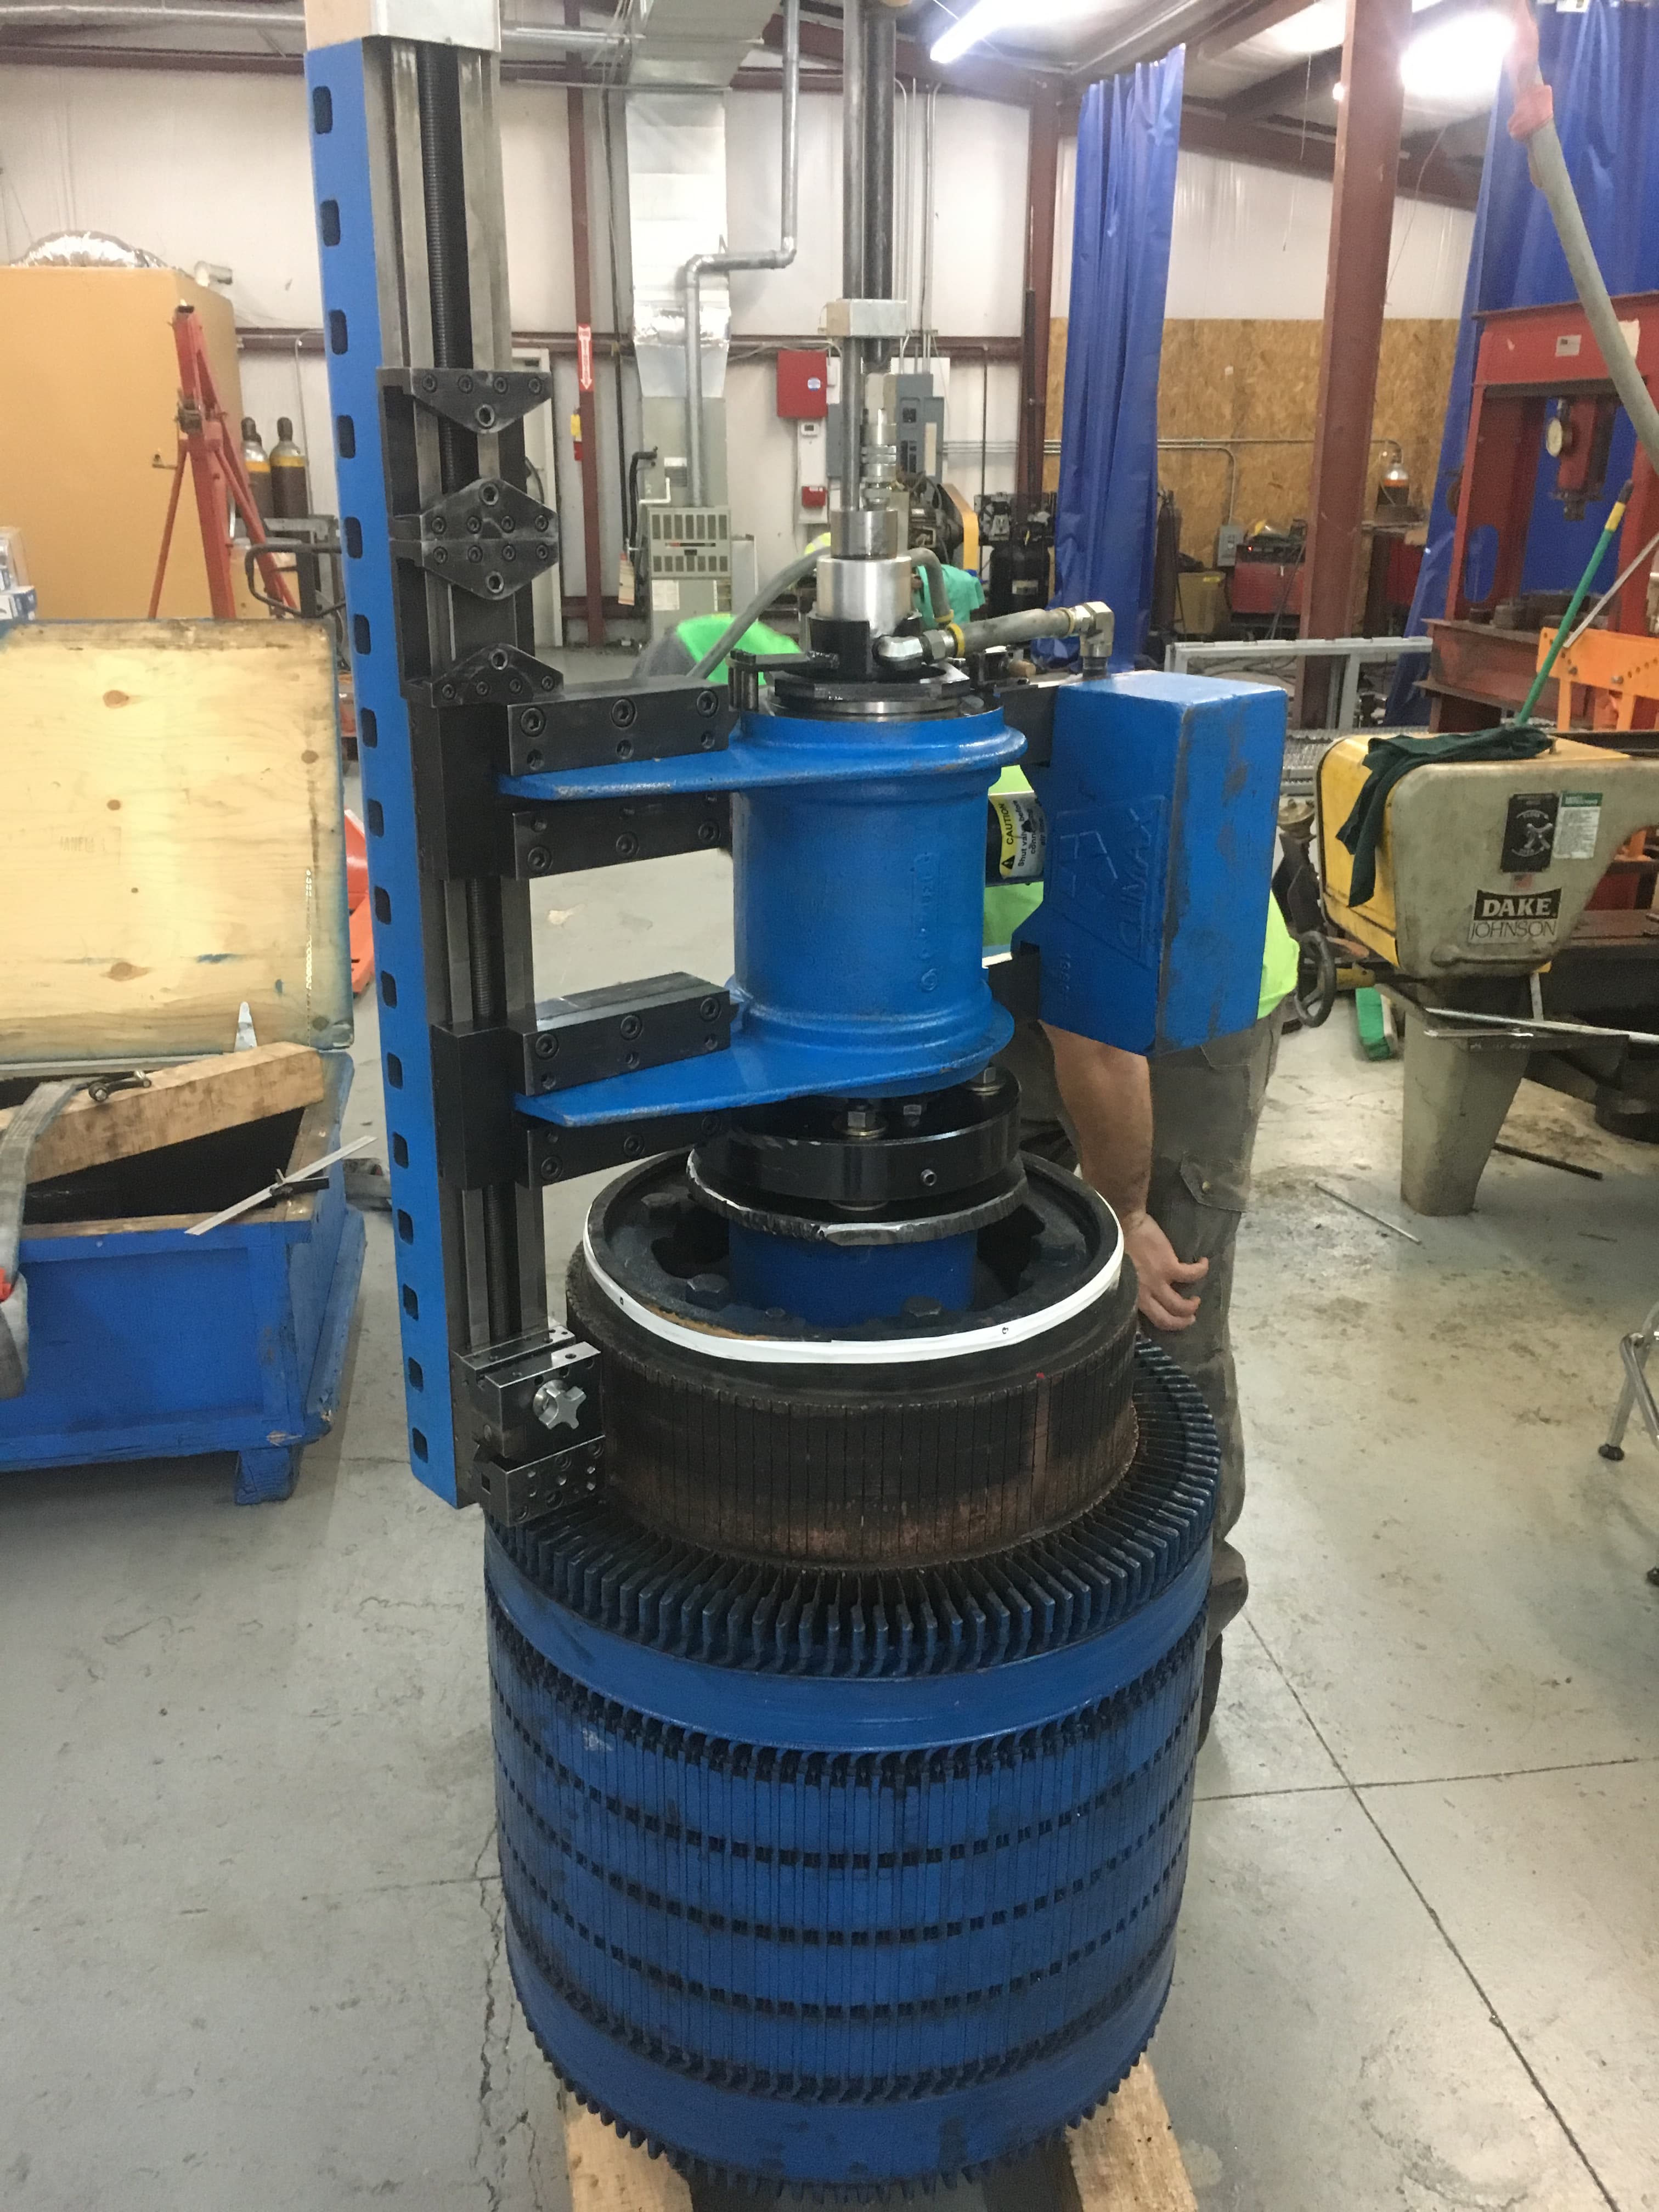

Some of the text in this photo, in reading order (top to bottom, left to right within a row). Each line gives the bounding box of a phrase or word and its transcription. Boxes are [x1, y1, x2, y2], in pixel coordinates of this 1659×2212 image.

[998, 803, 1014, 845] CAUTION
[1018, 849, 1028, 867] Shut
[1482, 898, 1551, 917] DAKE
[1471, 921, 1556, 940] JOHNSON
